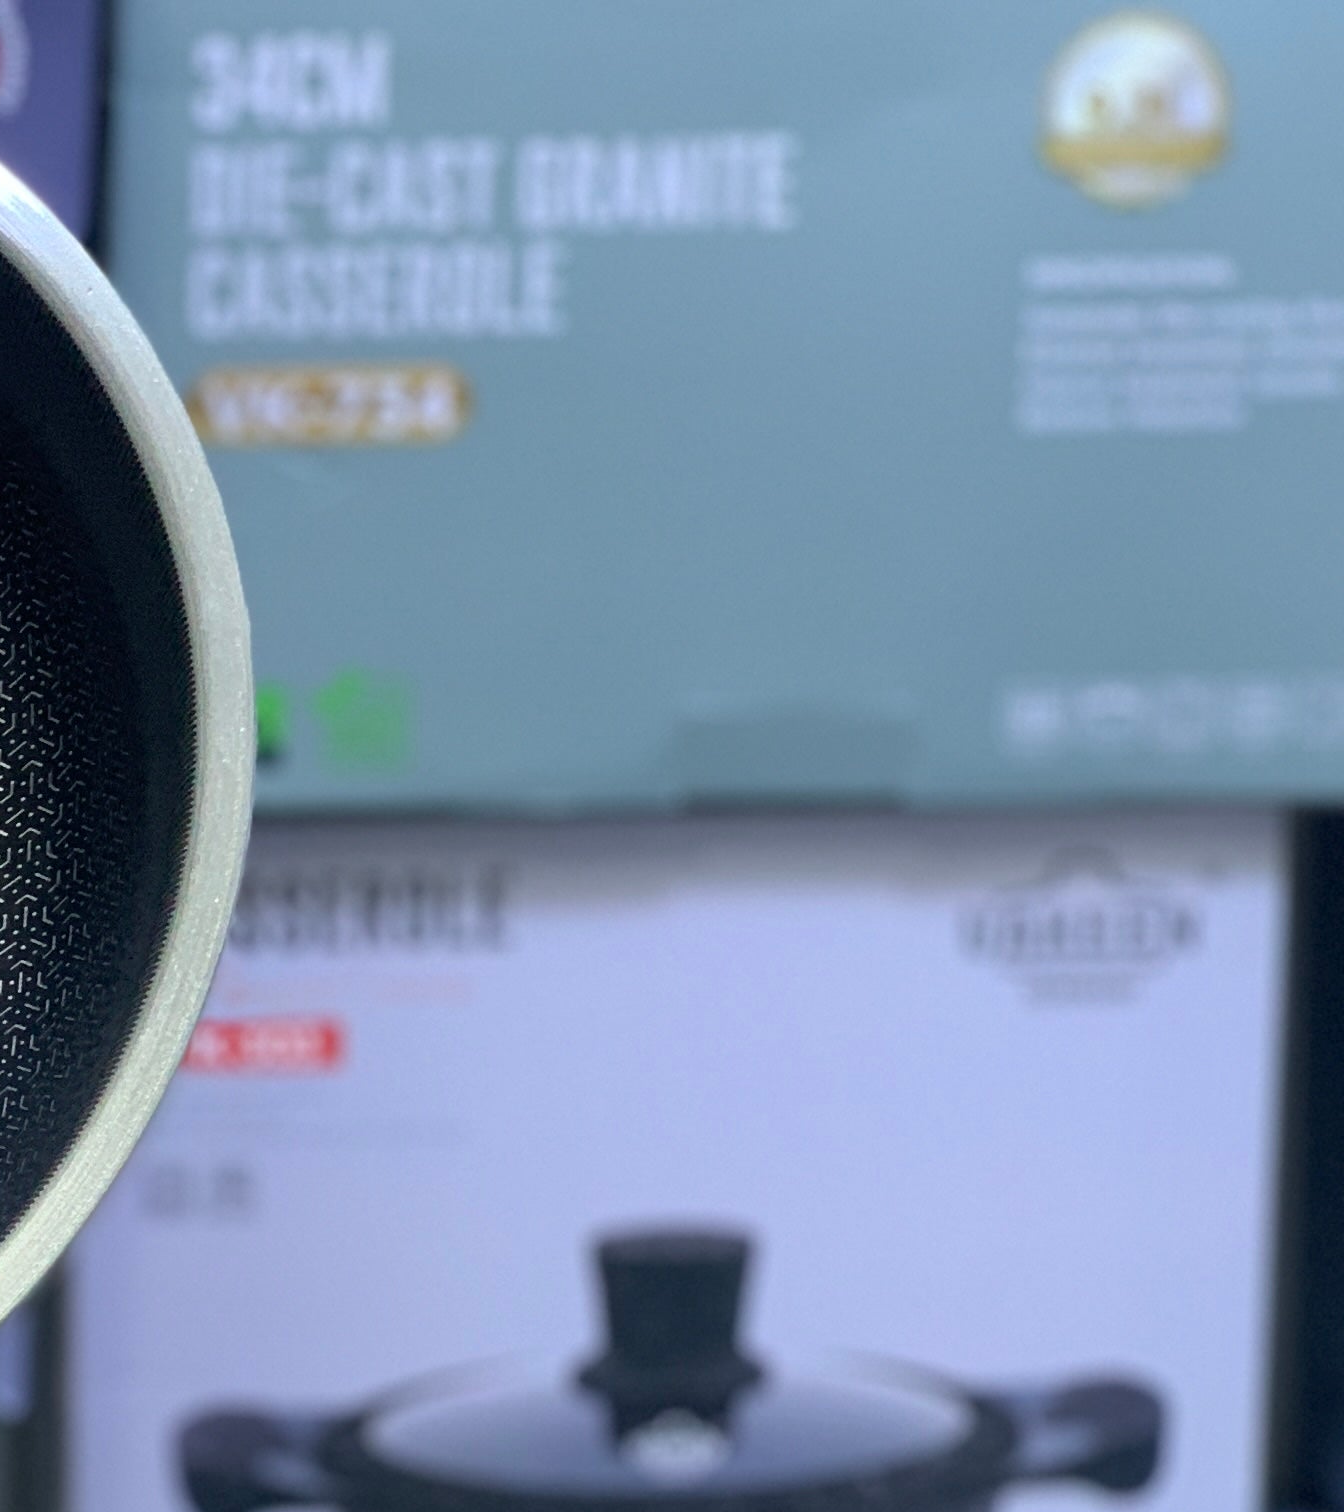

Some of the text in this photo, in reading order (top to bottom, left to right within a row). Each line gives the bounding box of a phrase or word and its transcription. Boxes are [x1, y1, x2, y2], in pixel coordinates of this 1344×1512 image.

[192, 32, 392, 130] 34CM
[192, 132, 794, 234] DIE-CAST GRANITE
[188, 242, 562, 339] CASSEROLE
